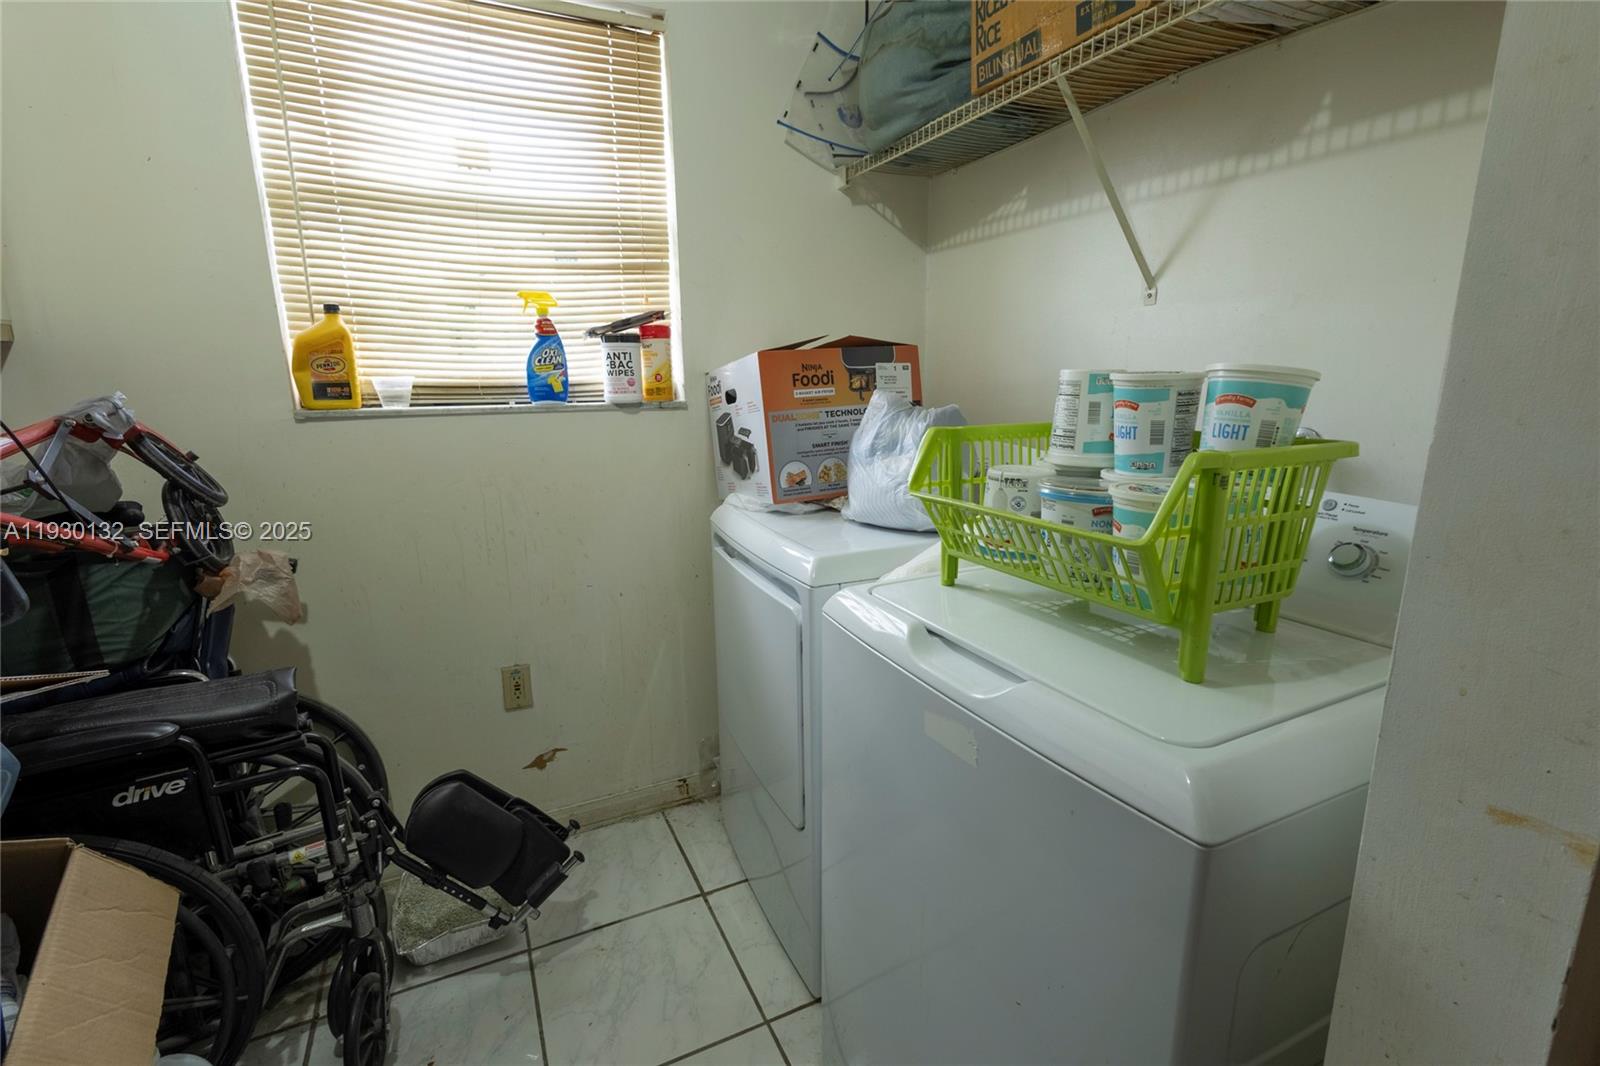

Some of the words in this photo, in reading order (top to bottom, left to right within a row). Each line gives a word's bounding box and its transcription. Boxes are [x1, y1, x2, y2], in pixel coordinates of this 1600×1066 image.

[976, 20, 1002, 56] RICE
[535, 356, 562, 366] CLEAN
[606, 351, 627, 361] ANTI
[607, 369, 635, 377] WIPES
[801, 363, 823, 373] NINJA
[792, 370, 835, 388] Foodi
[1212, 422, 1250, 441] LIGHT
[1091, 520, 1113, 529] NON
[112, 779, 186, 807] drive
